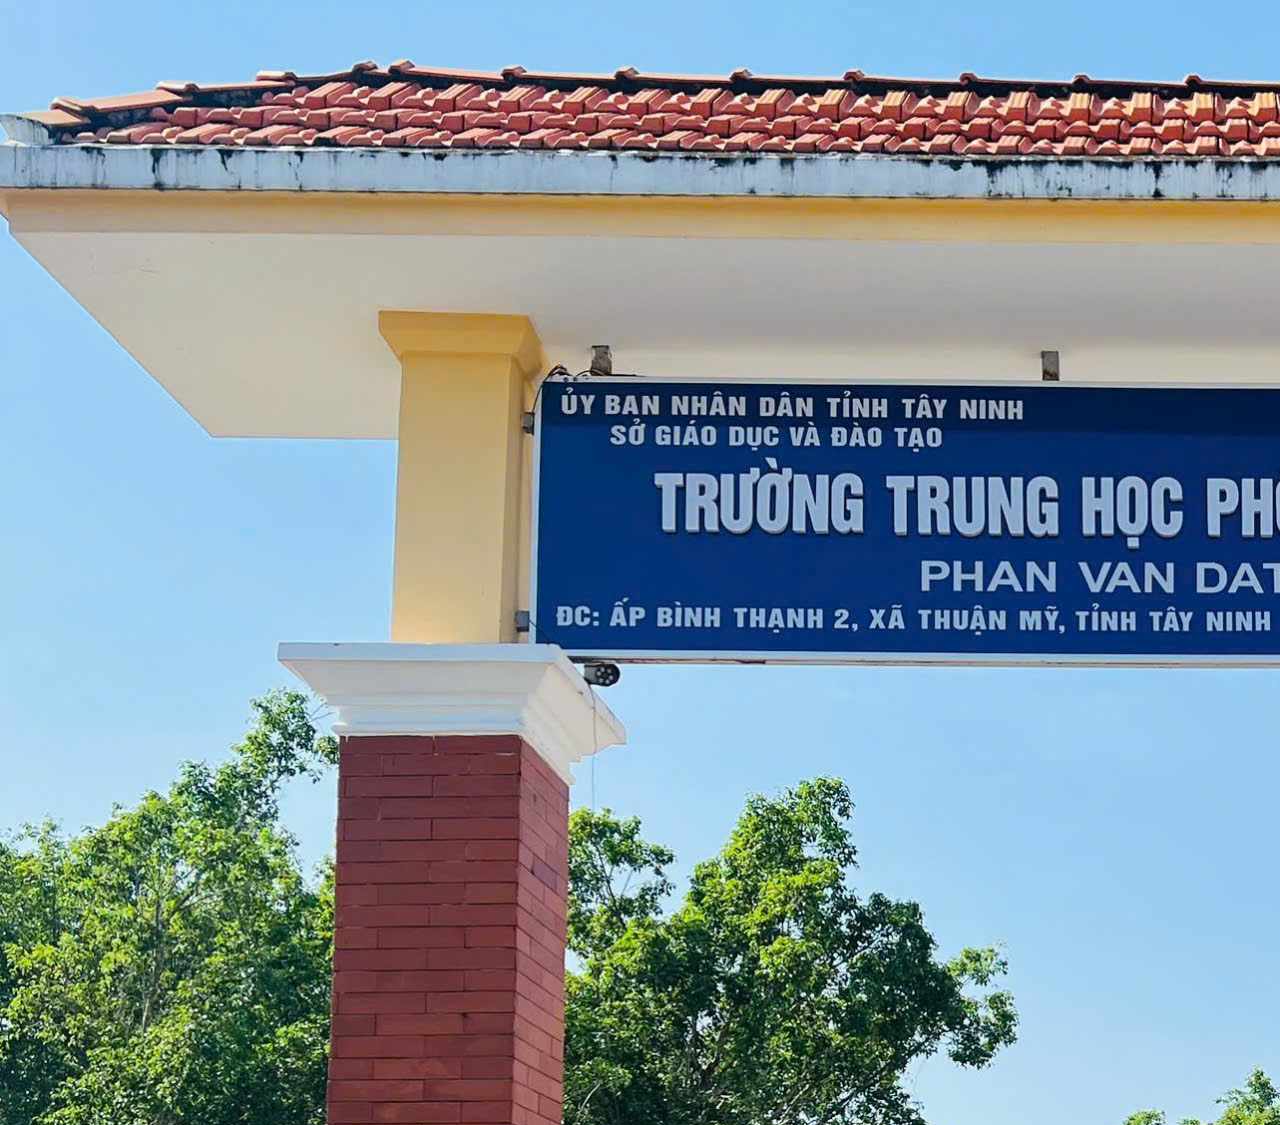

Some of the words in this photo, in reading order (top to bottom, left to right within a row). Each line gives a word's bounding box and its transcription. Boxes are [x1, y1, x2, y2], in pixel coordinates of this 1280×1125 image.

[561, 386, 594, 415] ỦY
[604, 394, 660, 415] BAN
[671, 391, 746, 416] NHÂN
[759, 392, 814, 418] DÂN
[827, 390, 888, 418] TỈNH
[901, 393, 948, 418] TÂY
[959, 399, 1024, 420] NINH
[609, 419, 646, 446] SỞ
[655, 419, 717, 446] GIÁO
[728, 425, 780, 451] DỤC
[789, 421, 821, 447] VÀ
[830, 421, 883, 447] ĐÀO
[893, 427, 943, 453] TẠO
[654, 456, 864, 534] TRƯỜNG
[885, 475, 1059, 537] TRUNG
[1081, 475, 1184, 549] HỌC
[921, 560, 1057, 593] PHAN
[1077, 561, 1175, 594] VAN
[555, 605, 600, 627] ĐC:
[609, 597, 646, 627] ẤP
[656, 601, 721, 628] BÌNH
[733, 607, 824, 634] THẠNH
[833, 608, 858, 632] 2,
[869, 604, 905, 630] XÃ
[917, 604, 1007, 636] THUẬN
[1019, 605, 1066, 634] MỸ,
[1075, 602, 1137, 632] TỈNH
[1148, 606, 1194, 632] TÂY
[1206, 610, 1271, 632] NINH
